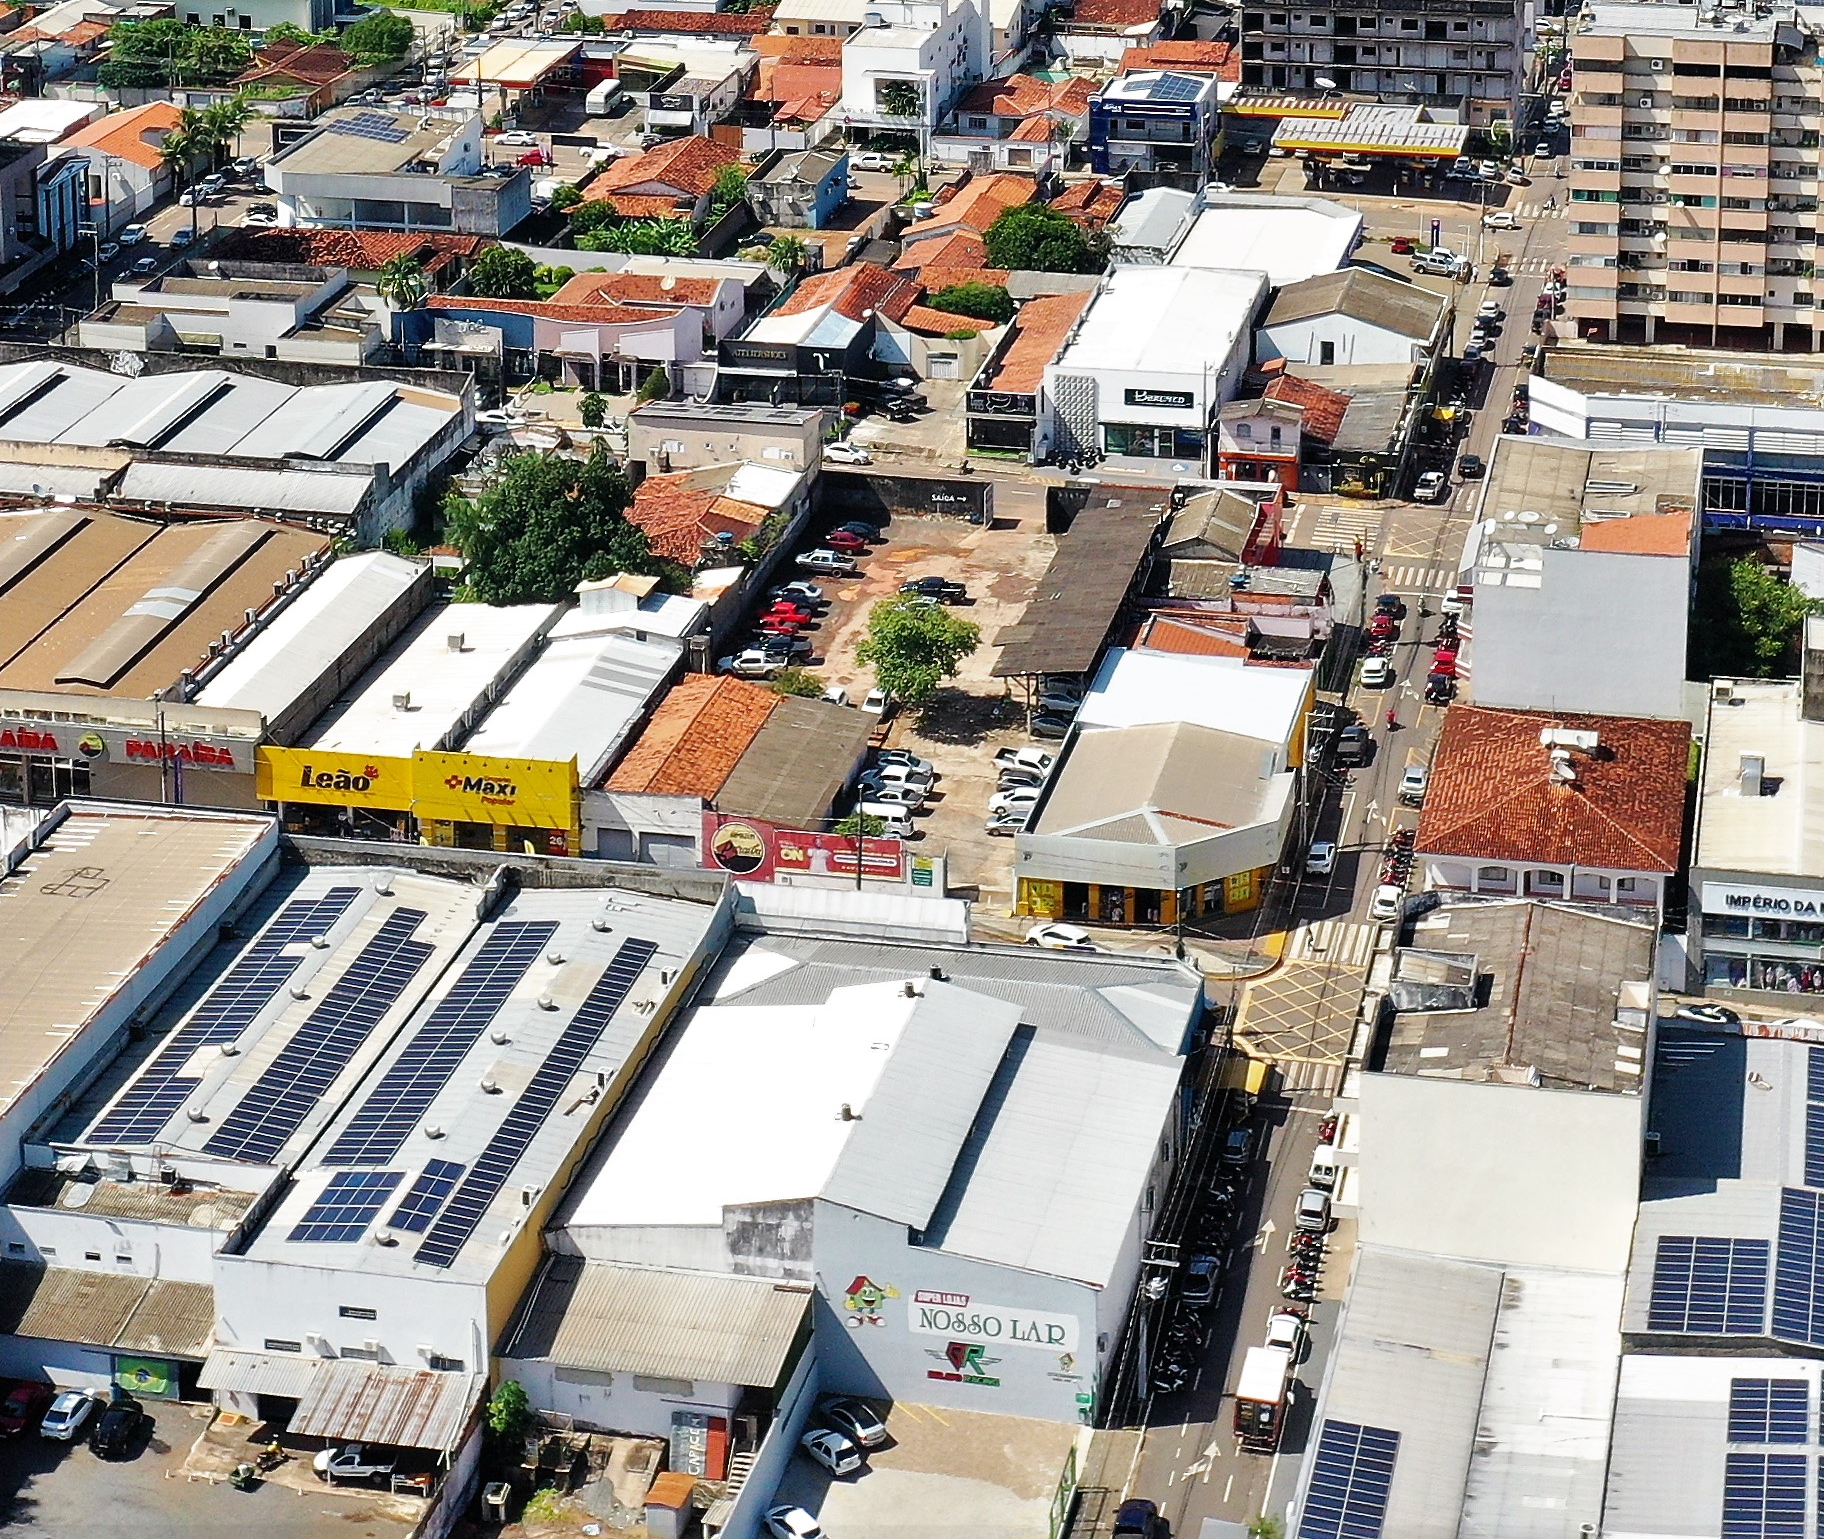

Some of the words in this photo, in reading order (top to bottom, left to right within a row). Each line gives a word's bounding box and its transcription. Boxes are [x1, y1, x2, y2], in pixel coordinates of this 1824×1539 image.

[125, 739, 235, 765] PARAÍBA
[300, 764, 372, 792] Leão
[463, 776, 517, 796] Maxi
[1725, 892, 1789, 911] IMPÉRIO
[1793, 898, 1818, 914] DA
[917, 1291, 942, 1303] SUPER
[942, 1293, 967, 1306] LOJAS
[919, 1308, 1003, 1338] NOSSO
[1009, 1319, 1067, 1346] LAR
